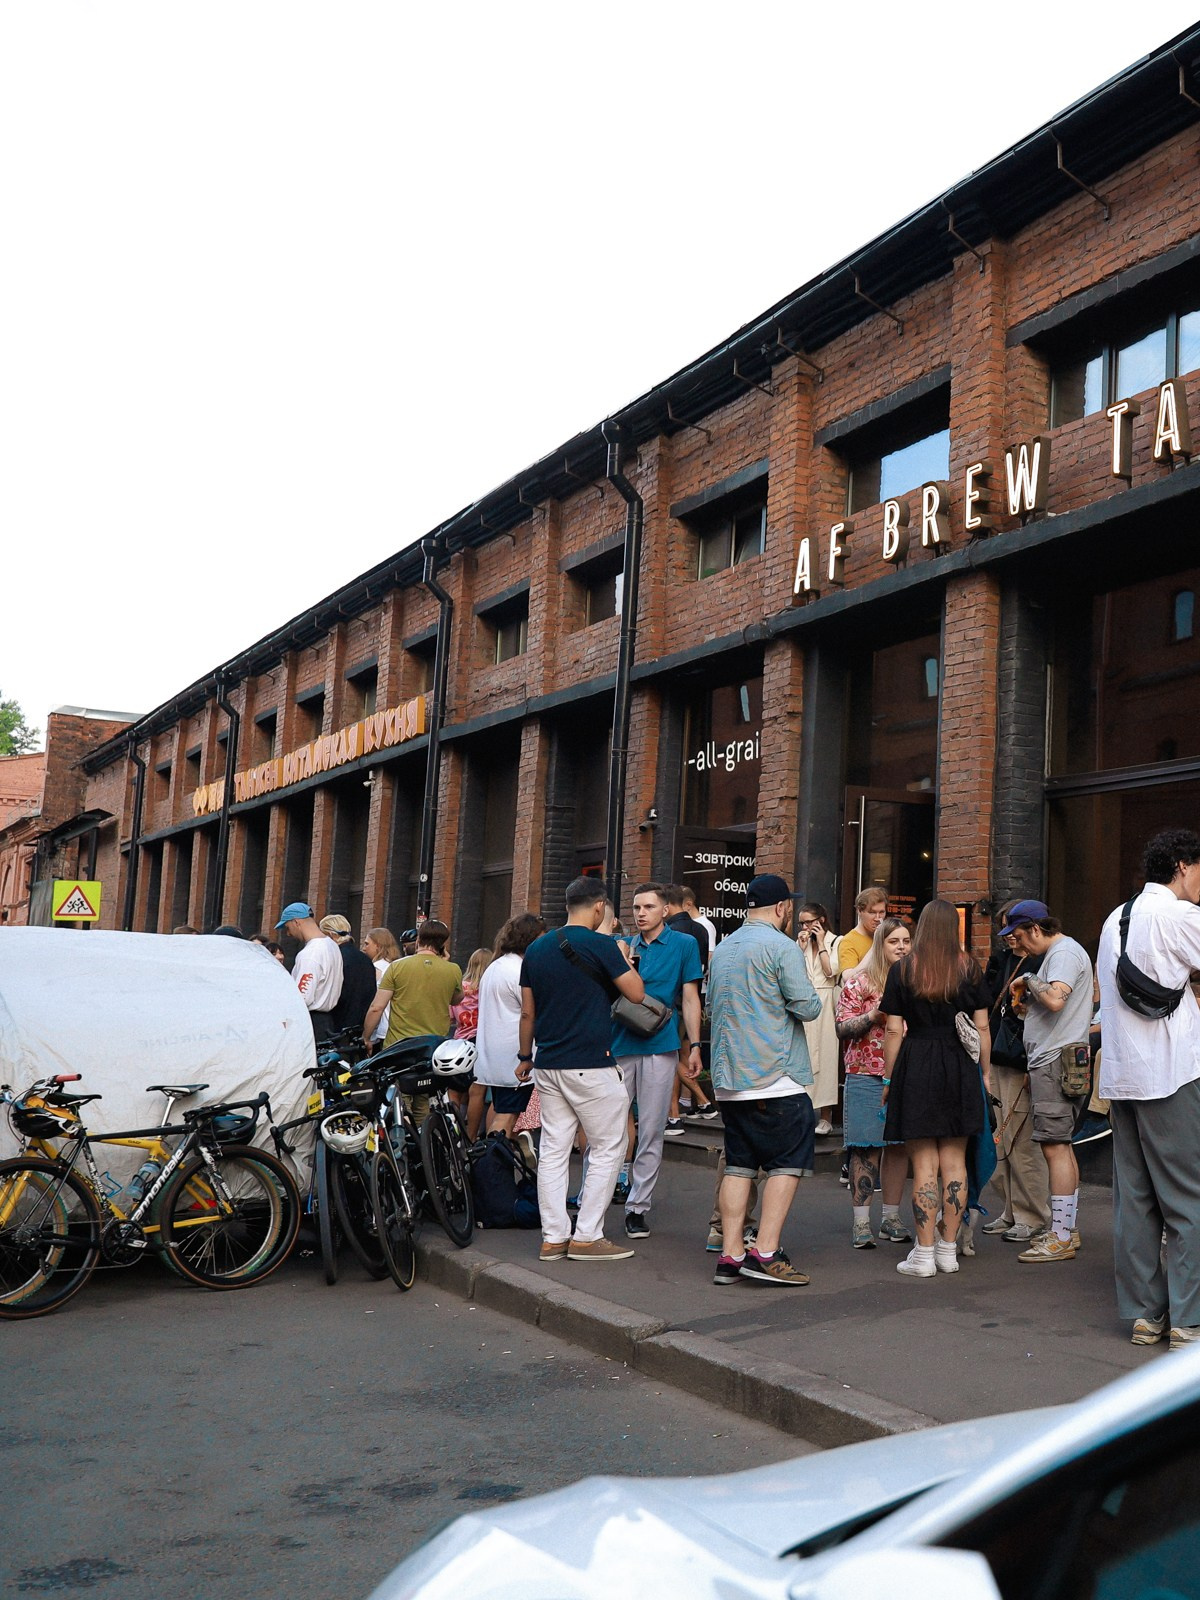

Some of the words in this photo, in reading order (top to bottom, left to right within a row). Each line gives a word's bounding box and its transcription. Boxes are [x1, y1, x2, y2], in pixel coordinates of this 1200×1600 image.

[793, 522, 851, 597] AF
[882, 438, 1047, 564] BREW
[283, 722, 361, 787] КИТАЙСКАЯ
[364, 696, 421, 753] КУХНЯ
[695, 852, 757, 868] завтраки
[714, 878, 749, 894] обед
[417, 1078, 432, 1087] PANIC
